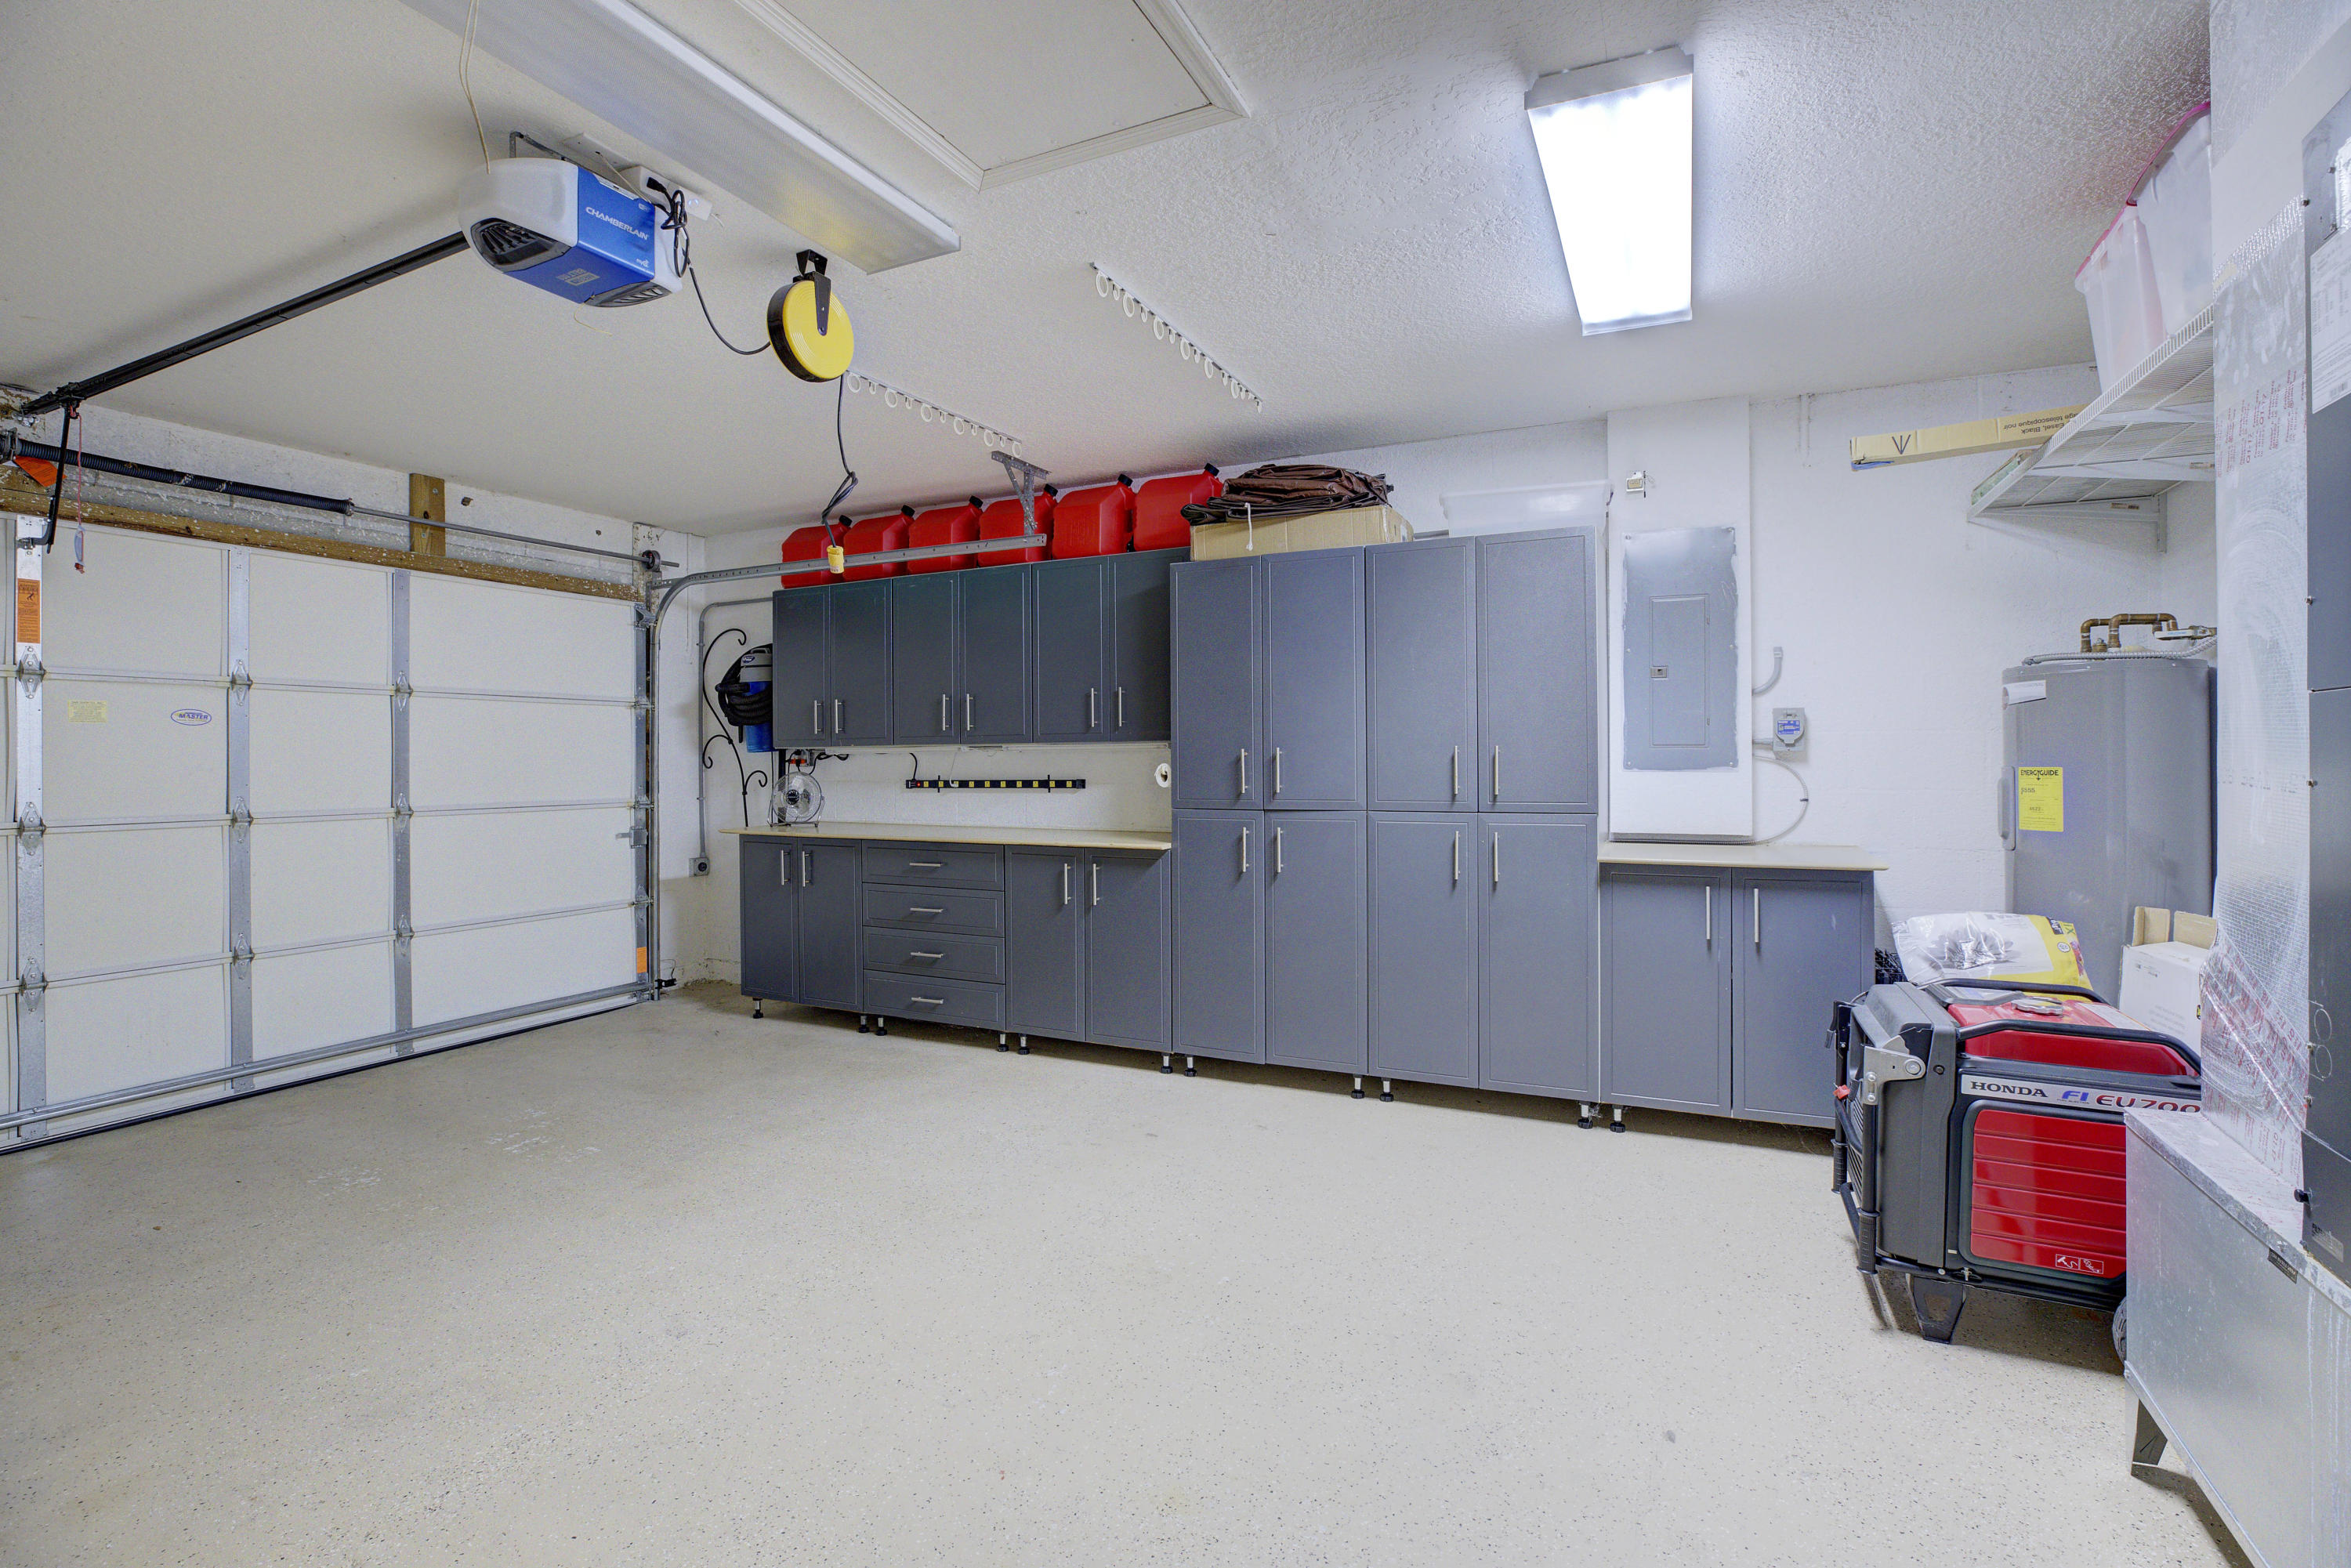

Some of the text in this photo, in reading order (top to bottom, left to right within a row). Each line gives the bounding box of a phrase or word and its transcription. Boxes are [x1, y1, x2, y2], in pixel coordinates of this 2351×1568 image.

[585, 207, 648, 241] CHAMBERLAIN
[2021, 425, 2041, 435] Black
[1970, 1081, 2048, 1098] HONDA
[2062, 1090, 2089, 1102] FI
